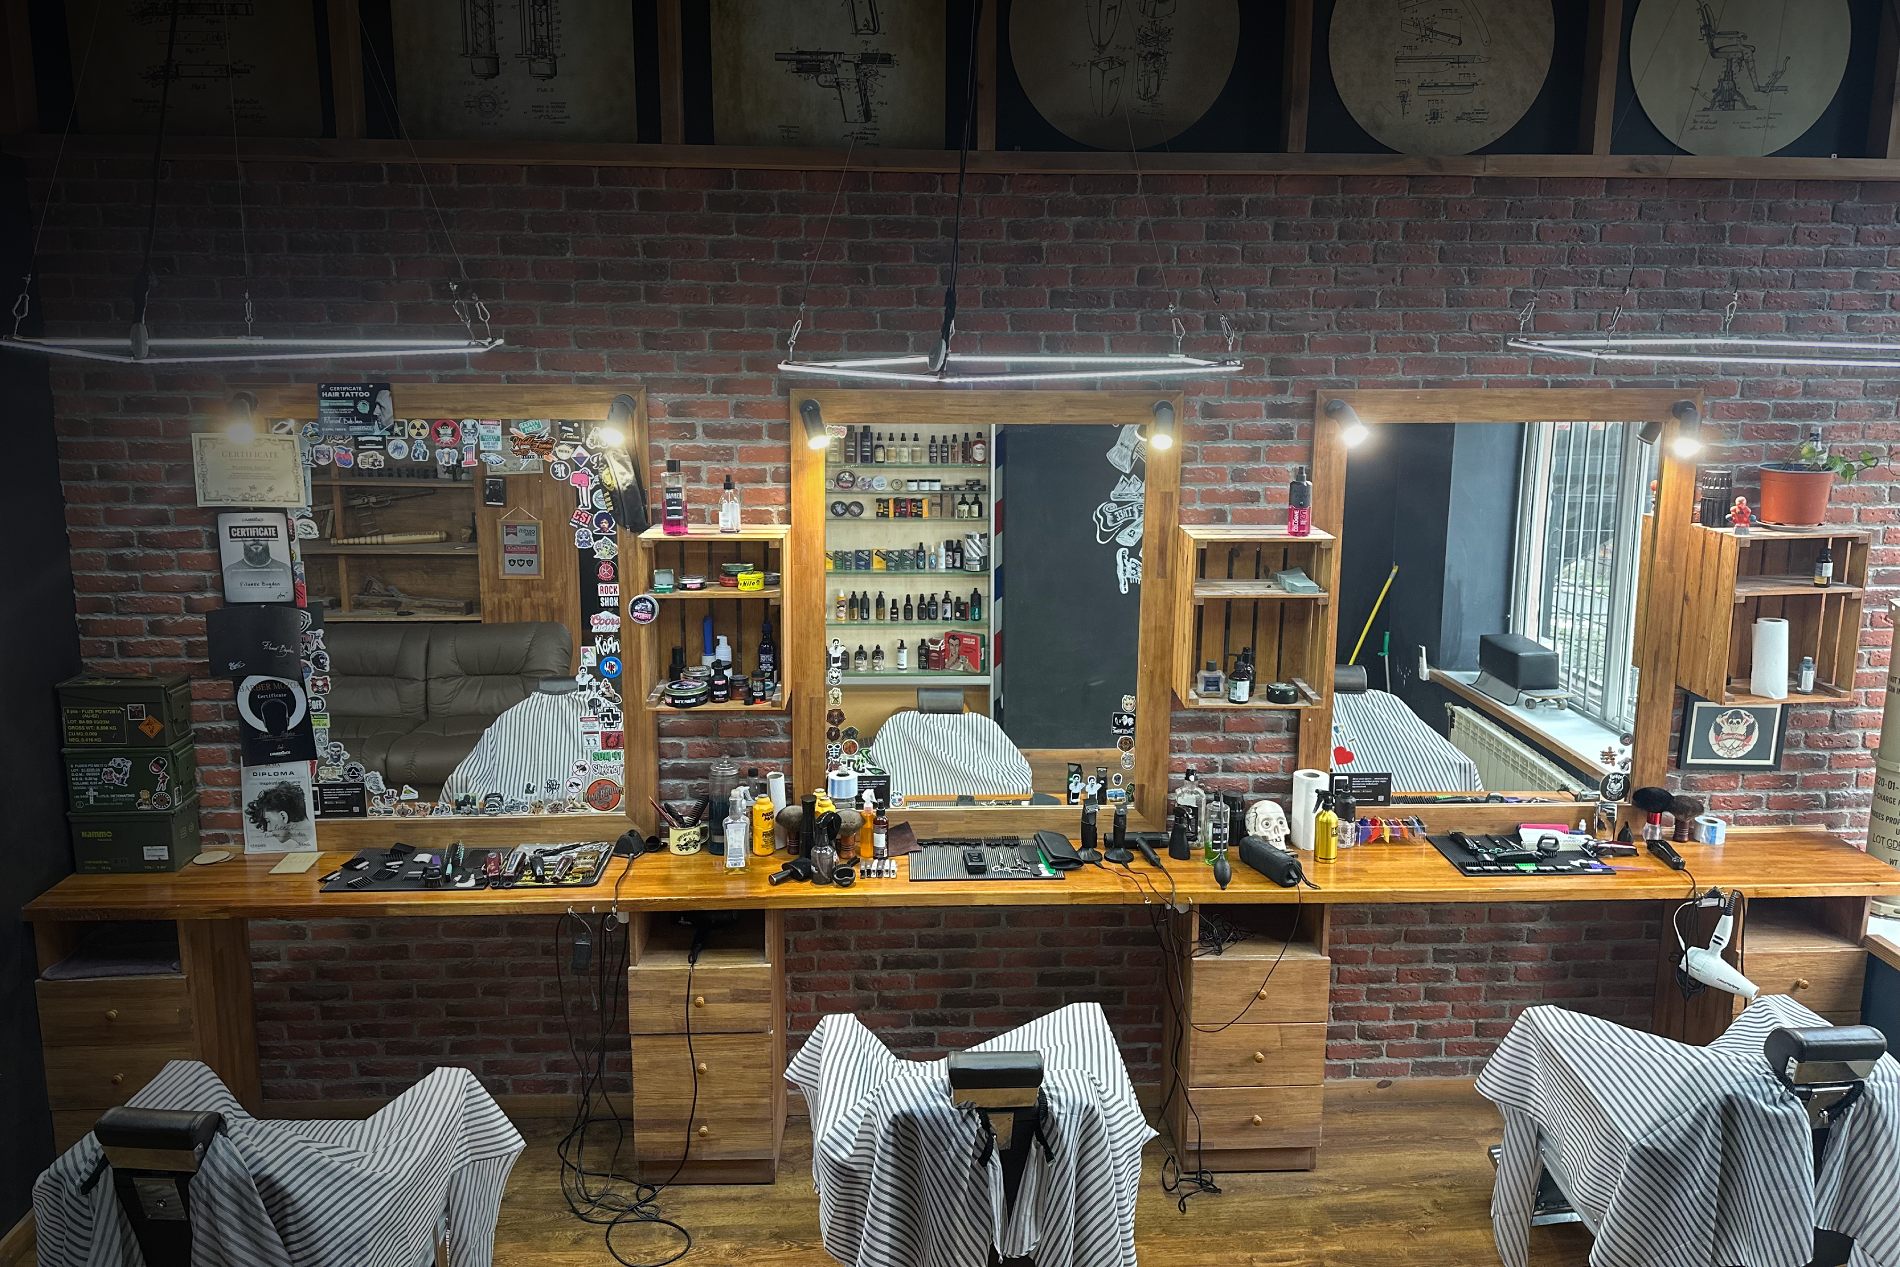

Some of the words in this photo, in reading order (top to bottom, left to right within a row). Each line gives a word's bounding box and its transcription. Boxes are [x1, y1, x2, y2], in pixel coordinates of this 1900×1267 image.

[221, 451, 278, 459] CERTIFICATE
[231, 527, 277, 537] CERTIFICATE
[600, 585, 618, 595] ROCK
[600, 597, 619, 607] SHOX
[592, 615, 621, 626] Coors
[1873, 833, 1885, 846] LOT
[1887, 838, 1900, 850] GD
[1889, 857, 1899, 867] WT
